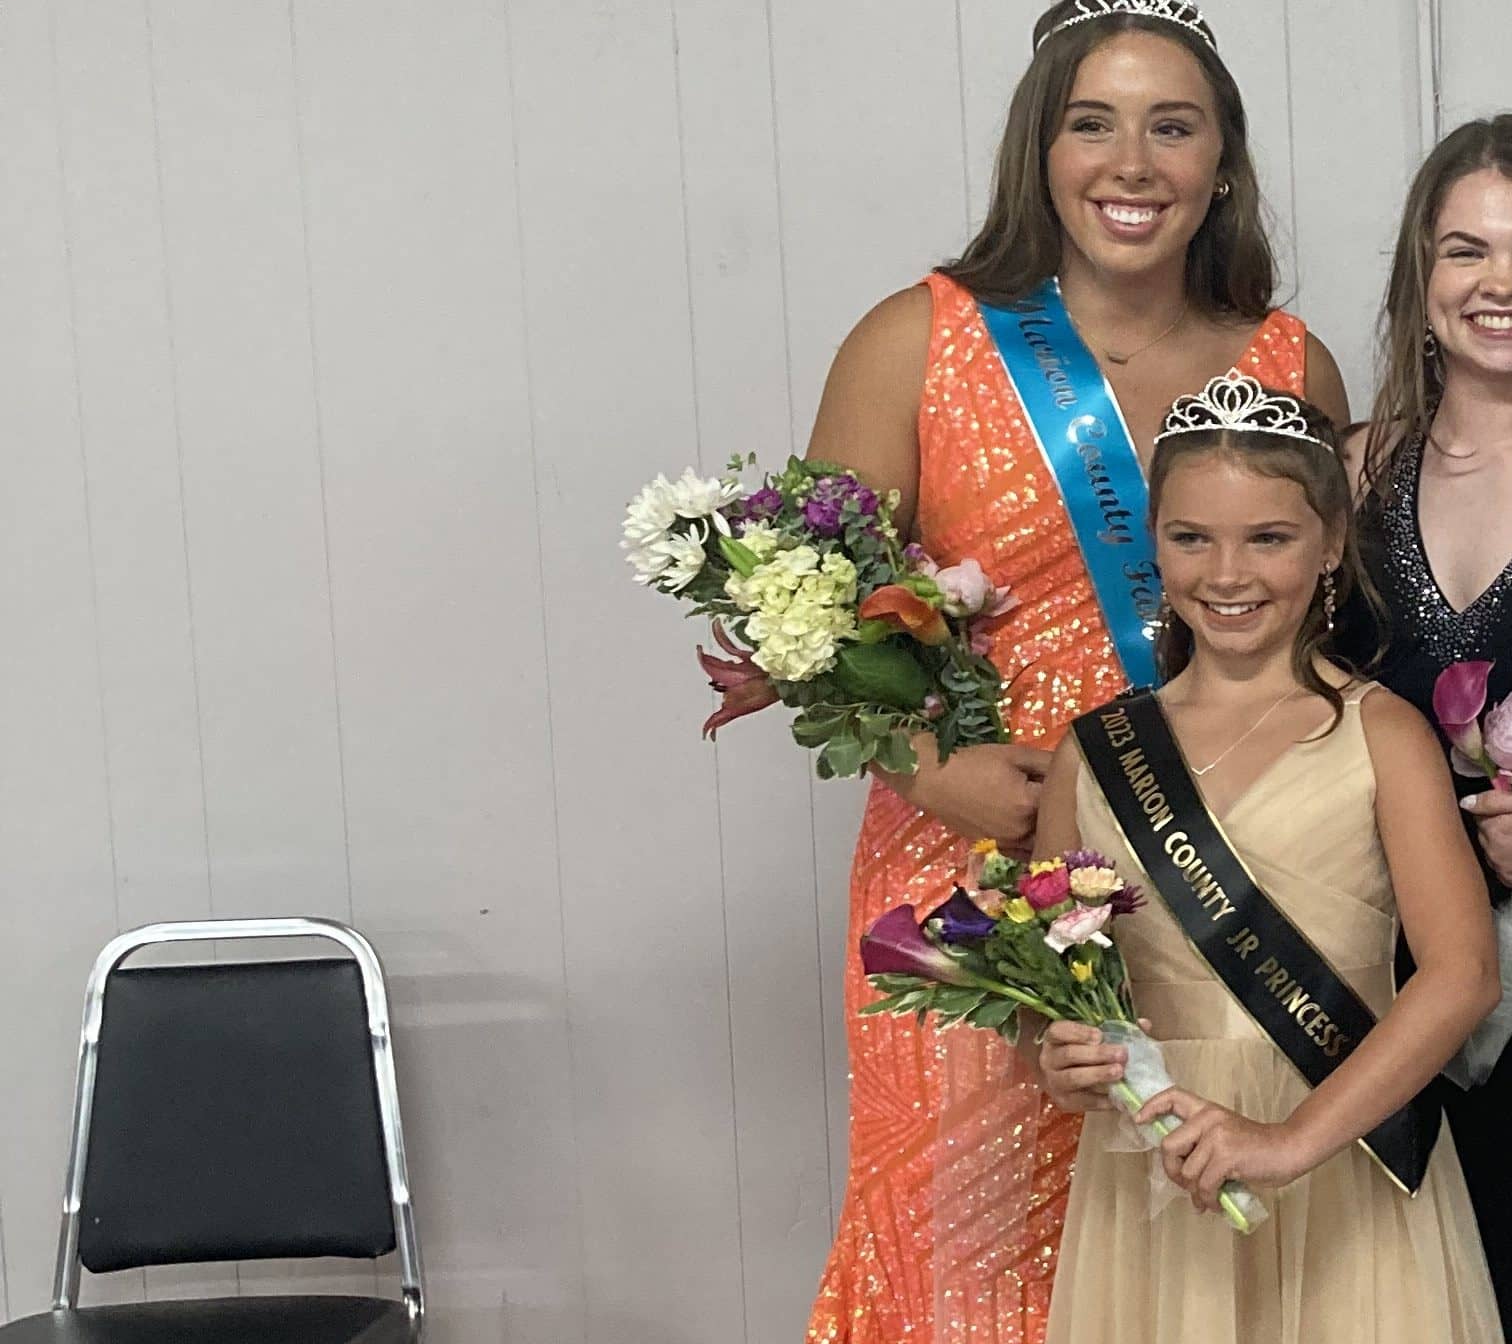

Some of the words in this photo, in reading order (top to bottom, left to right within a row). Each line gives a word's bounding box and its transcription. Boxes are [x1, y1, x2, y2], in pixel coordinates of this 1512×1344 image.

[1066, 414, 1135, 545] County
[1099, 707, 1136, 748] 2023
[1119, 747, 1175, 833] MARION
[1163, 831, 1237, 922] COUNTY
[1227, 926, 1261, 960] JR
[1254, 957, 1352, 1059] PRINCESS
